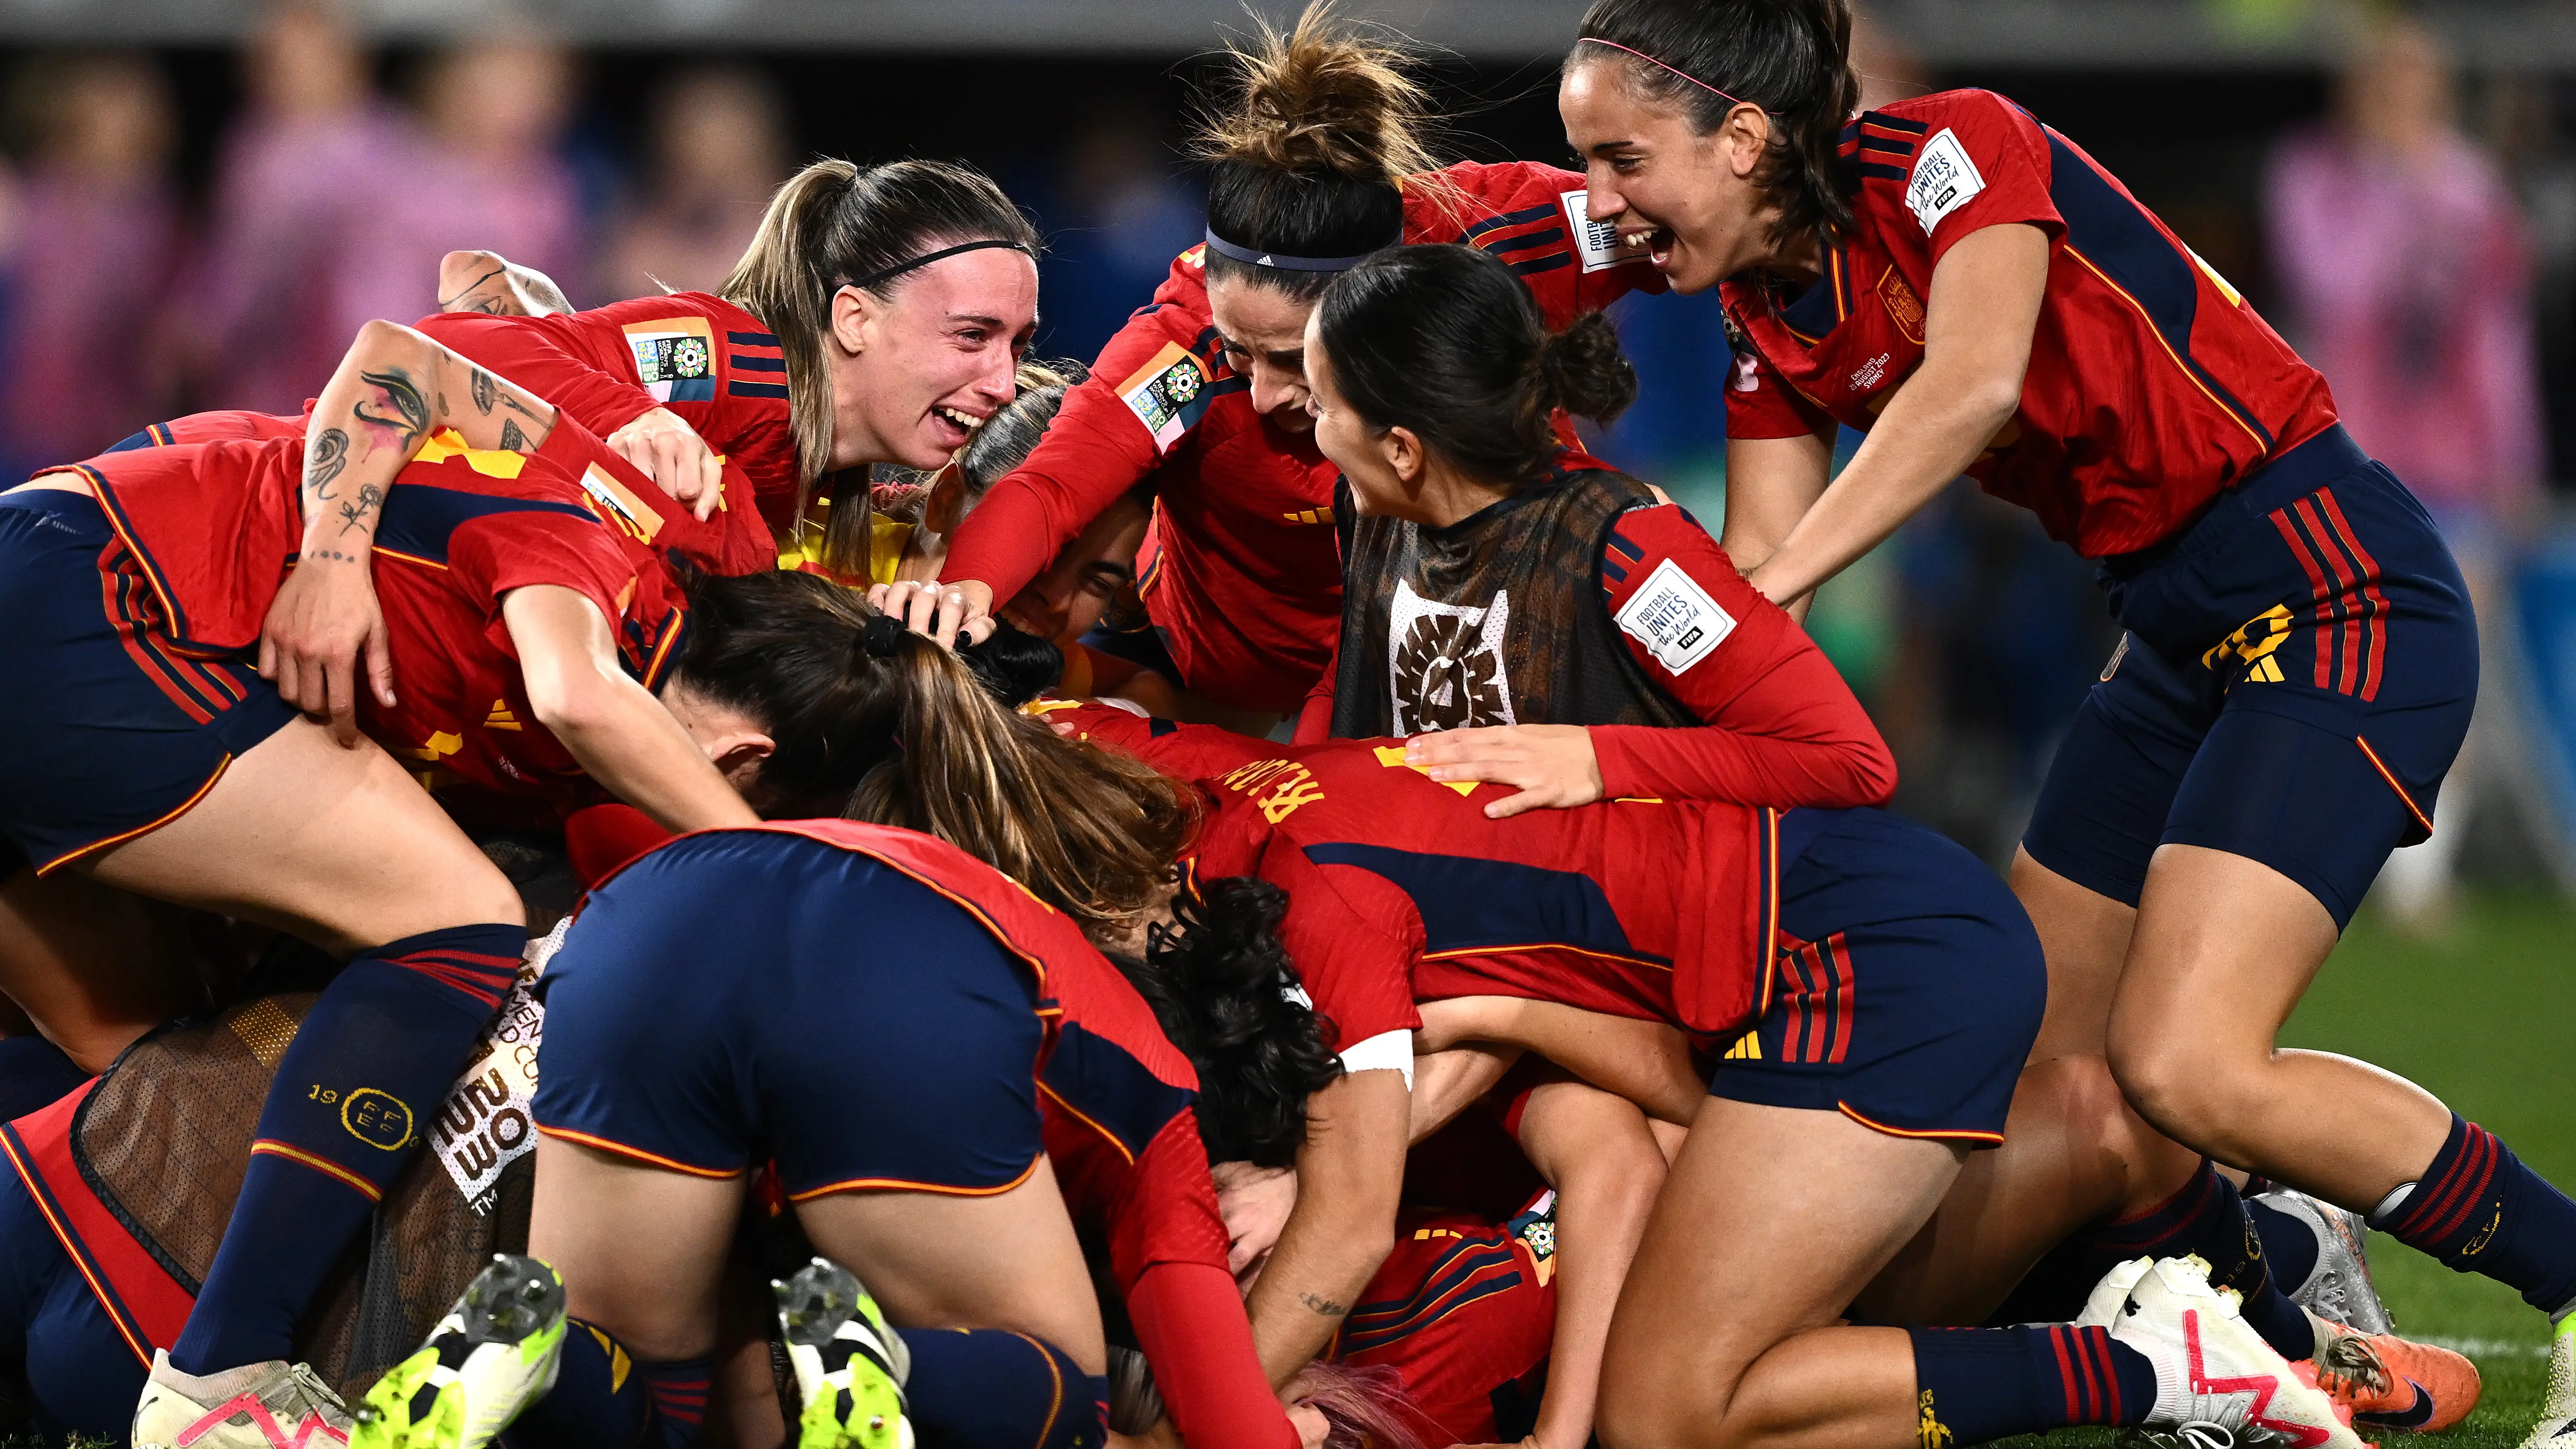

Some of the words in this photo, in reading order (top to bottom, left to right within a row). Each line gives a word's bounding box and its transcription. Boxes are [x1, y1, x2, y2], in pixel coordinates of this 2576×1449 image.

[1910, 150, 1943, 189] FOOTBALL
[1915, 157, 1950, 197] UNITES
[1921, 193, 1933, 210] the
[1932, 166, 1959, 195] World
[1937, 189, 1955, 207] FIFA
[1583, 209, 1602, 252] FOOTB
[1600, 219, 1619, 250] UNIT
[638, 343, 648, 360] NZ
[646, 342, 656, 360] AU
[1851, 358, 1876, 381] ENGLAND
[1855, 365, 1877, 387] AUGUST
[1874, 352, 1890, 368] 2023
[1864, 368, 1884, 389] SYDNEY
[1149, 386, 1162, 404] WORLD
[1152, 383, 1168, 406] WOMEN'S
[1155, 379, 1165, 393] FIFA
[1134, 397, 1151, 415] NZ
[1140, 392, 1156, 408] AU
[1637, 587, 1675, 625] FOOTBALL
[1646, 595, 1687, 636] UNITES
[1659, 632, 1675, 646] the
[1670, 604, 1701, 635] World
[1681, 629, 1701, 647] FIFA
[308, 1084, 338, 1104] 19
[471, 1188, 499, 1217] TM
